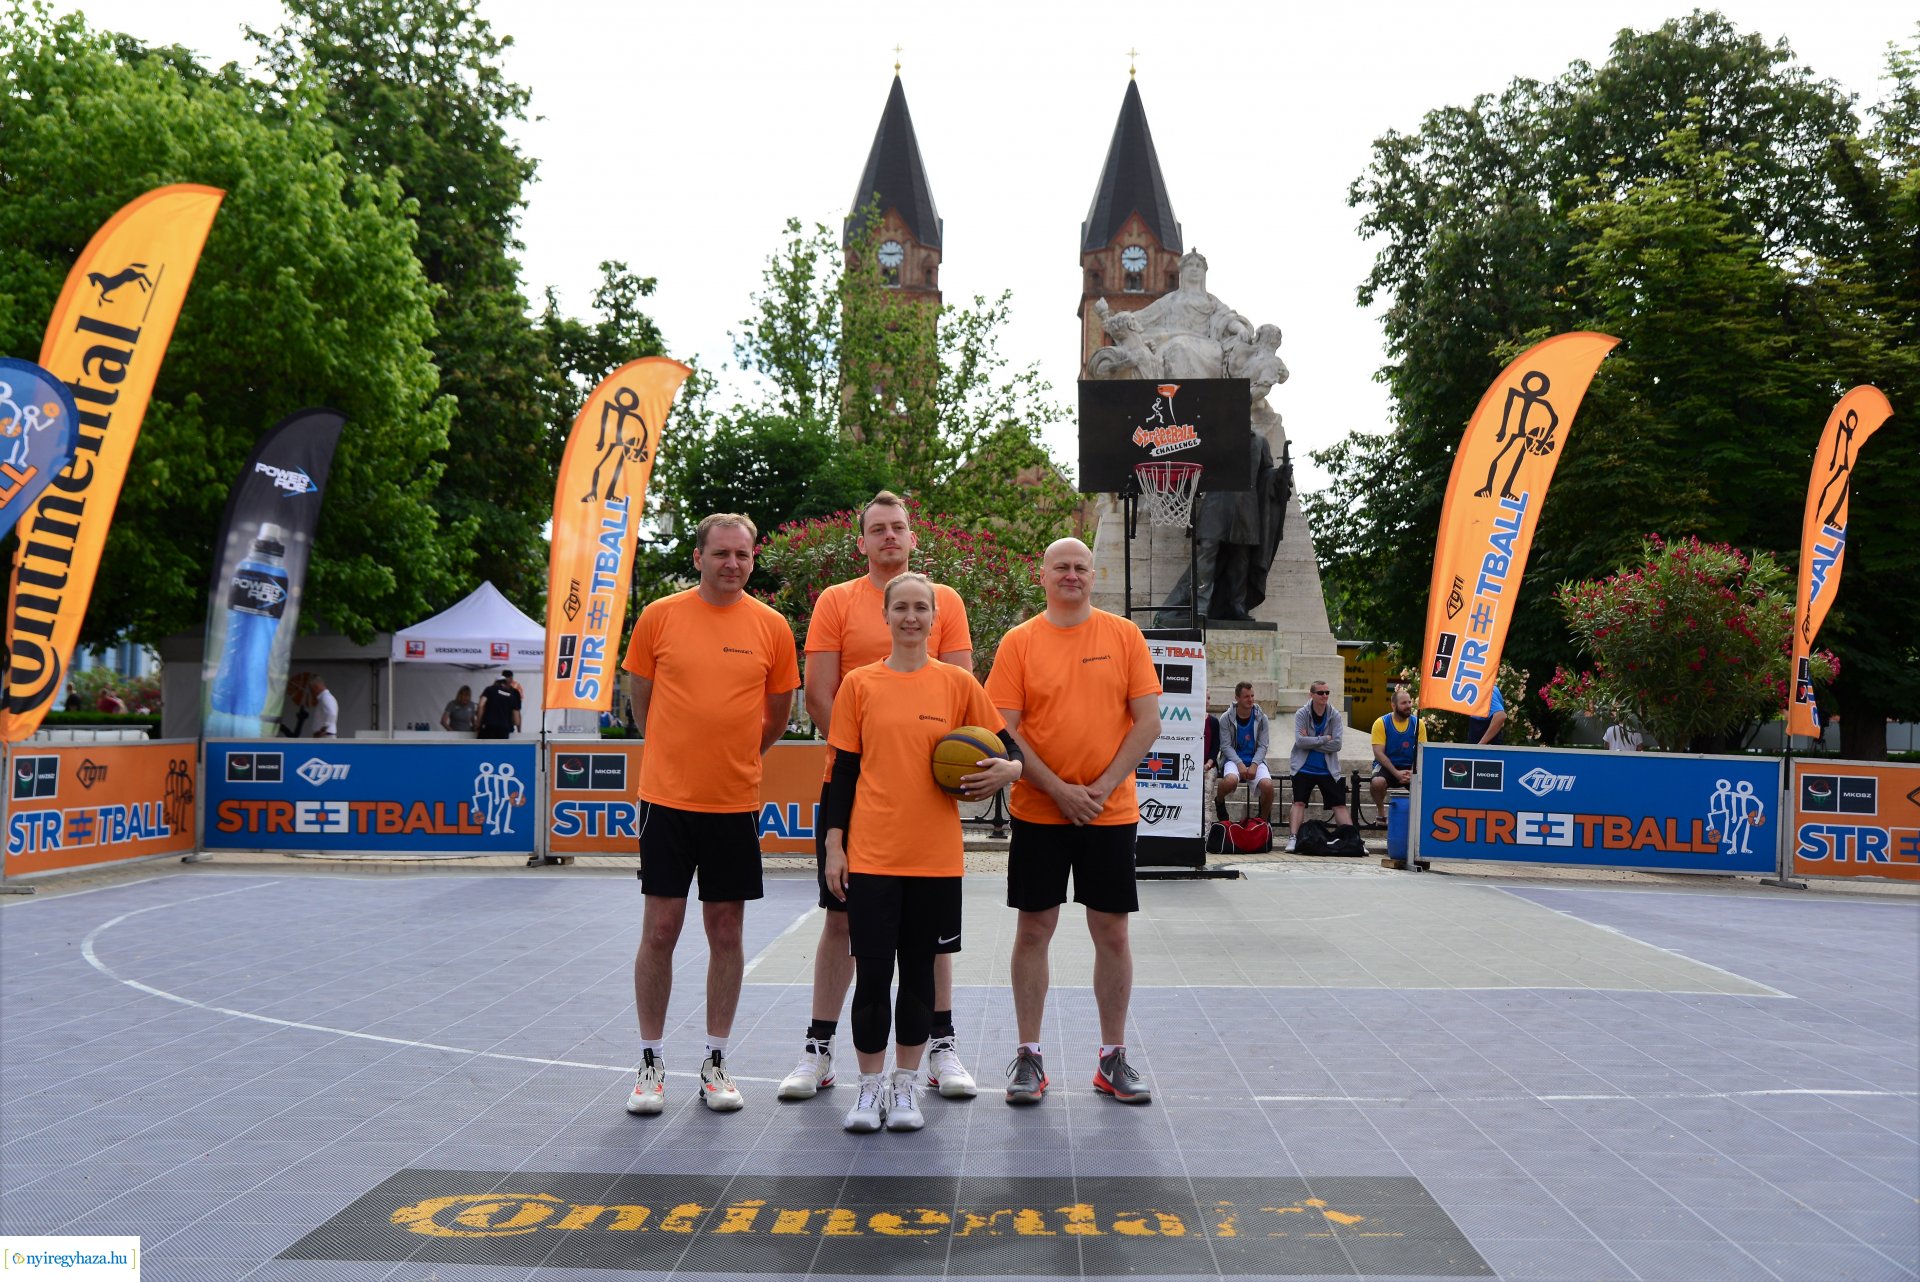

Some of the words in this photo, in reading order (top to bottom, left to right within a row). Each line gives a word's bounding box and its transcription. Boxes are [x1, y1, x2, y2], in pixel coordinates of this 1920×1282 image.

[1156, 439, 1198, 455] CHALLENGE
[255, 462, 310, 483] POWER
[3, 315, 142, 715] Continental
[574, 497, 629, 701] STREETBALL
[1450, 491, 1529, 707] STREETBALL
[1159, 706, 1191, 721] VM
[308, 764, 351, 781] TOTI
[1530, 773, 1577, 791] TOTI
[7, 801, 170, 856] STREETBALL
[216, 800, 482, 835] STREETBALL
[1431, 807, 1718, 855] STREETBALL
